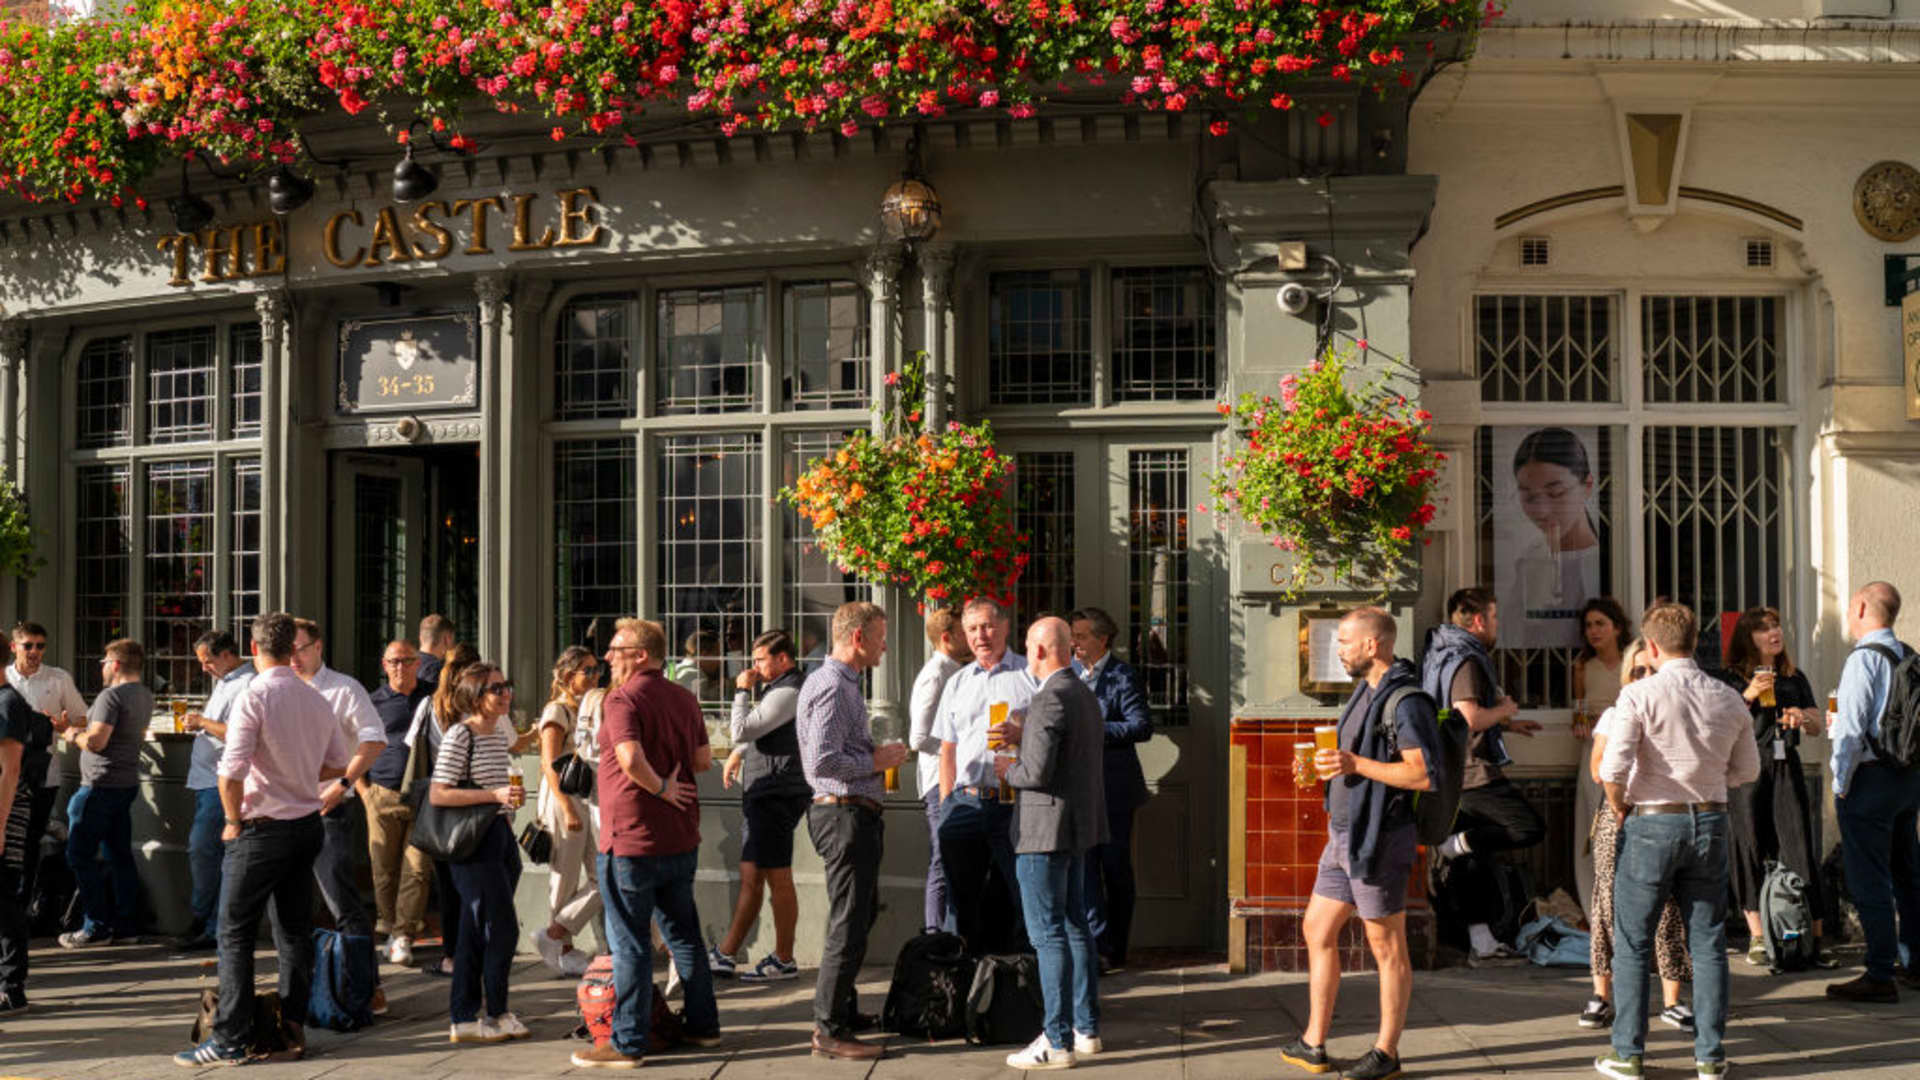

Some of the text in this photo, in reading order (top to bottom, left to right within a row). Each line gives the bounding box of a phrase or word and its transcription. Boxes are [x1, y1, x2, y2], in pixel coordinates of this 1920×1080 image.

[157, 186, 602, 287] THE CASTLE
[376, 374, 435, 397] 34-35
